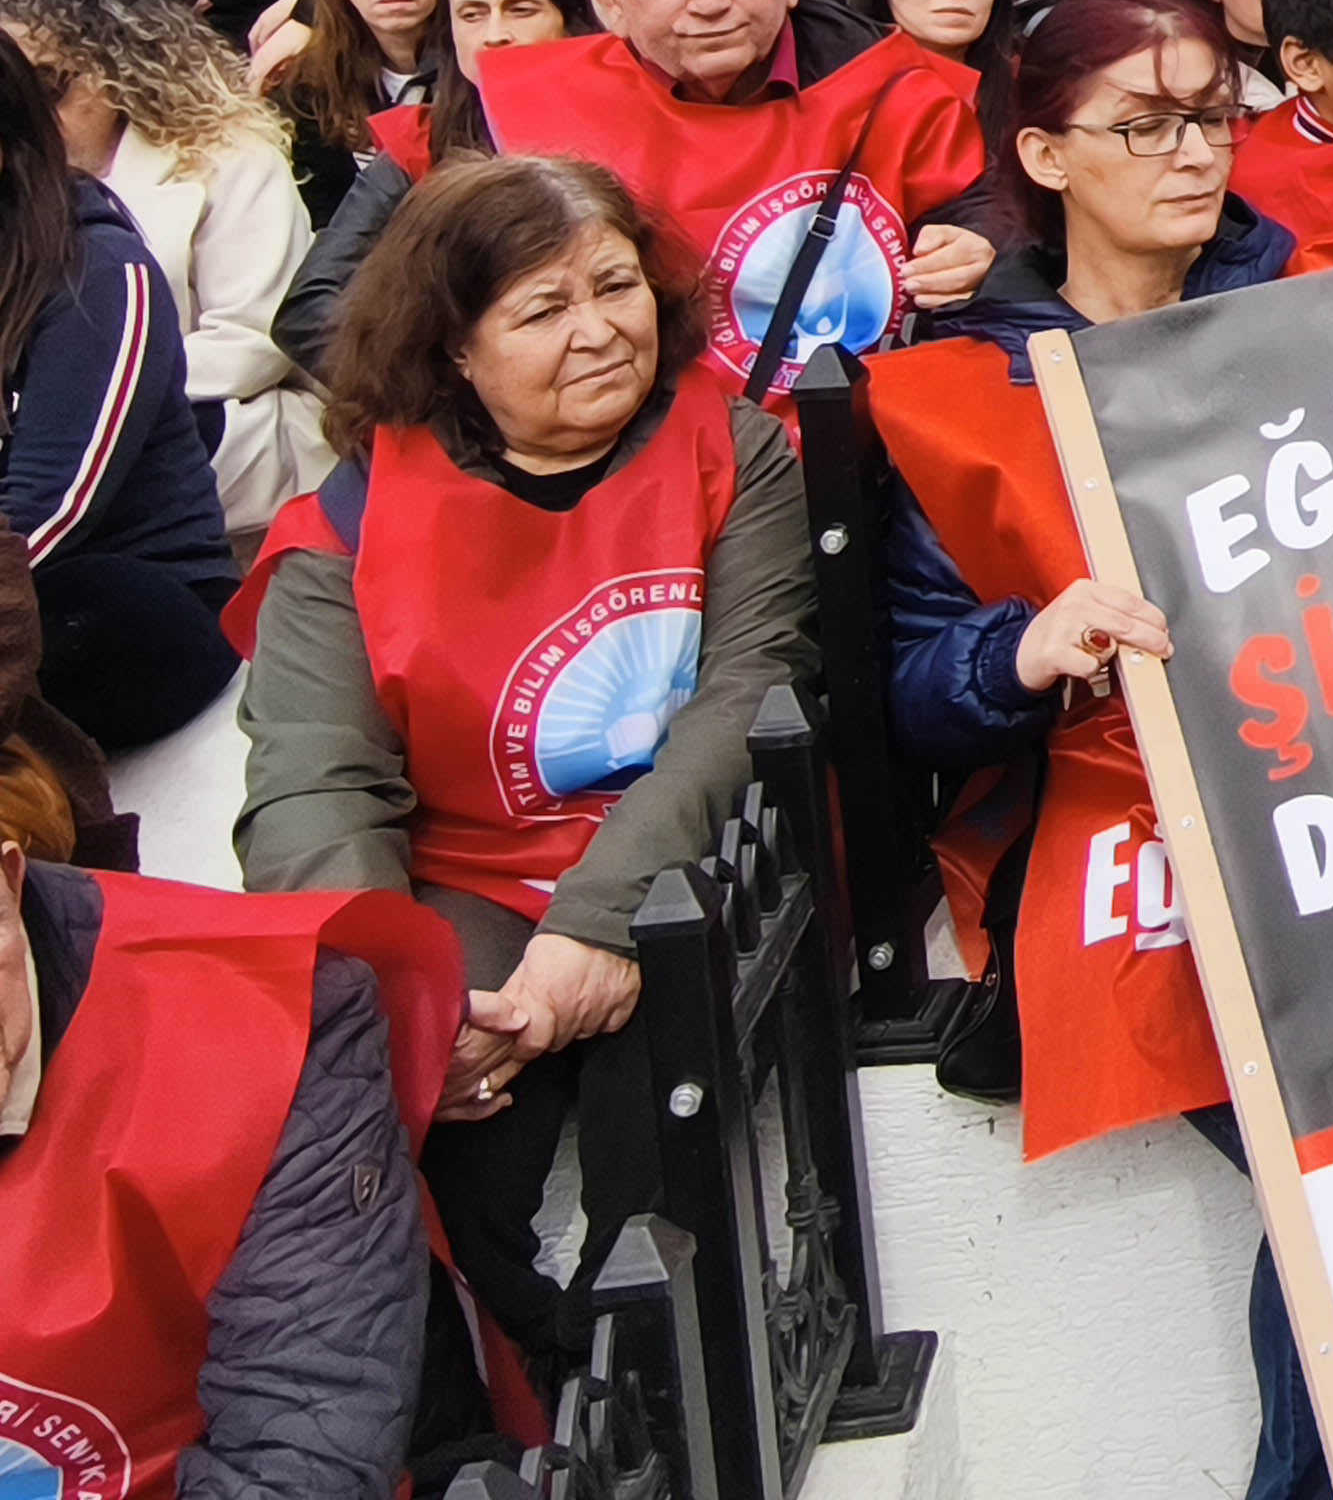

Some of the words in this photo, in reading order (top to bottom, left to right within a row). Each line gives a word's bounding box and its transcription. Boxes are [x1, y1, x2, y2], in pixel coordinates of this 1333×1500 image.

[719, 216, 762, 273] BİLİM
[560, 582, 702, 645] İŞGÖRENL
[514, 644, 566, 715] BİLİM
[506, 722, 529, 755] VE
